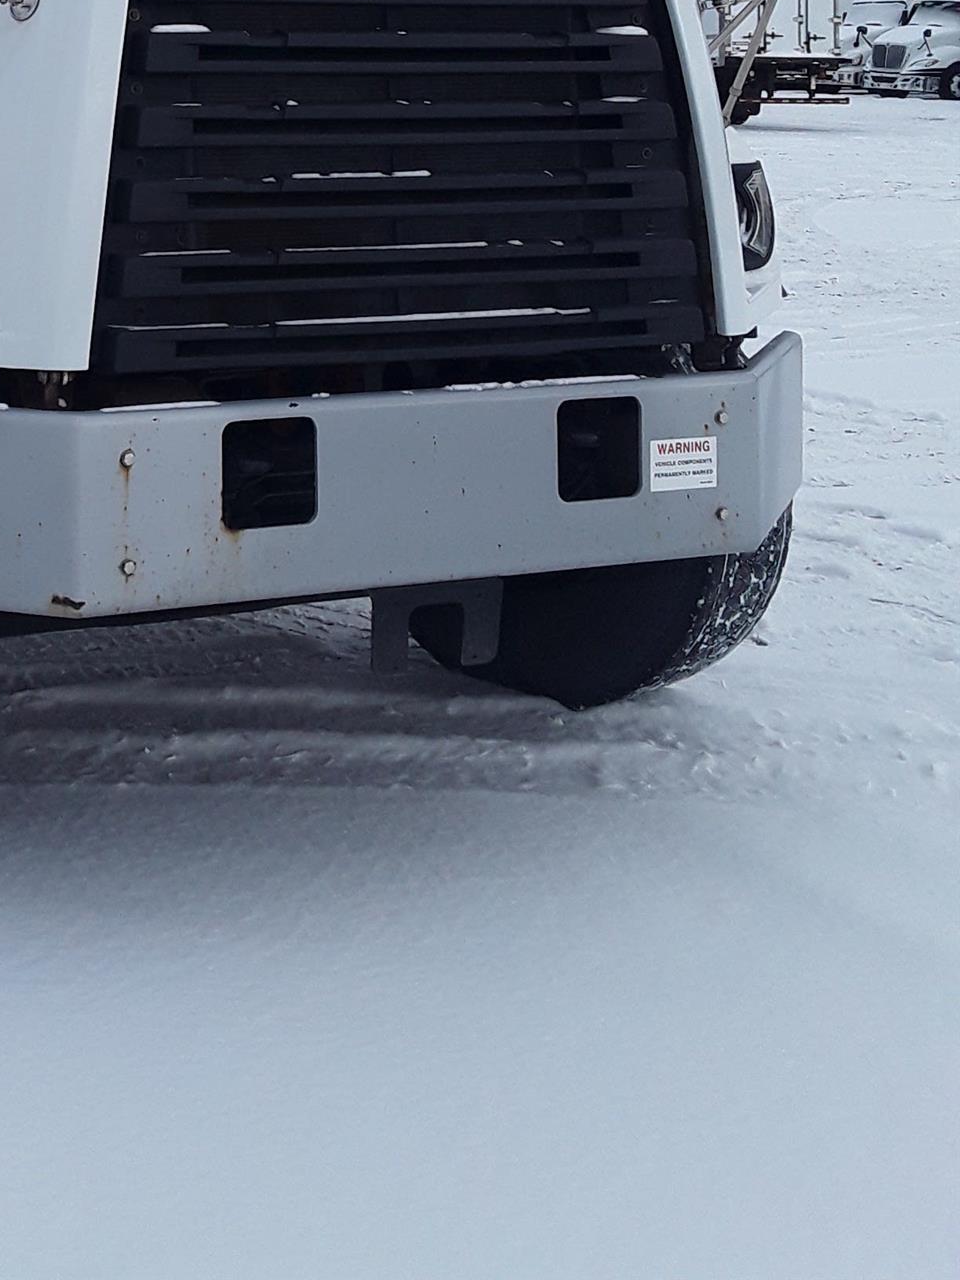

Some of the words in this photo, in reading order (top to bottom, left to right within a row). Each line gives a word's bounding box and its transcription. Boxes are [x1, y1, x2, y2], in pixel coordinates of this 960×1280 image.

[657, 440, 711, 455] WARNING
[677, 458, 713, 466] COMPONENTS
[654, 470, 691, 478] PERMANENTLY
[692, 468, 714, 476] MARKED
